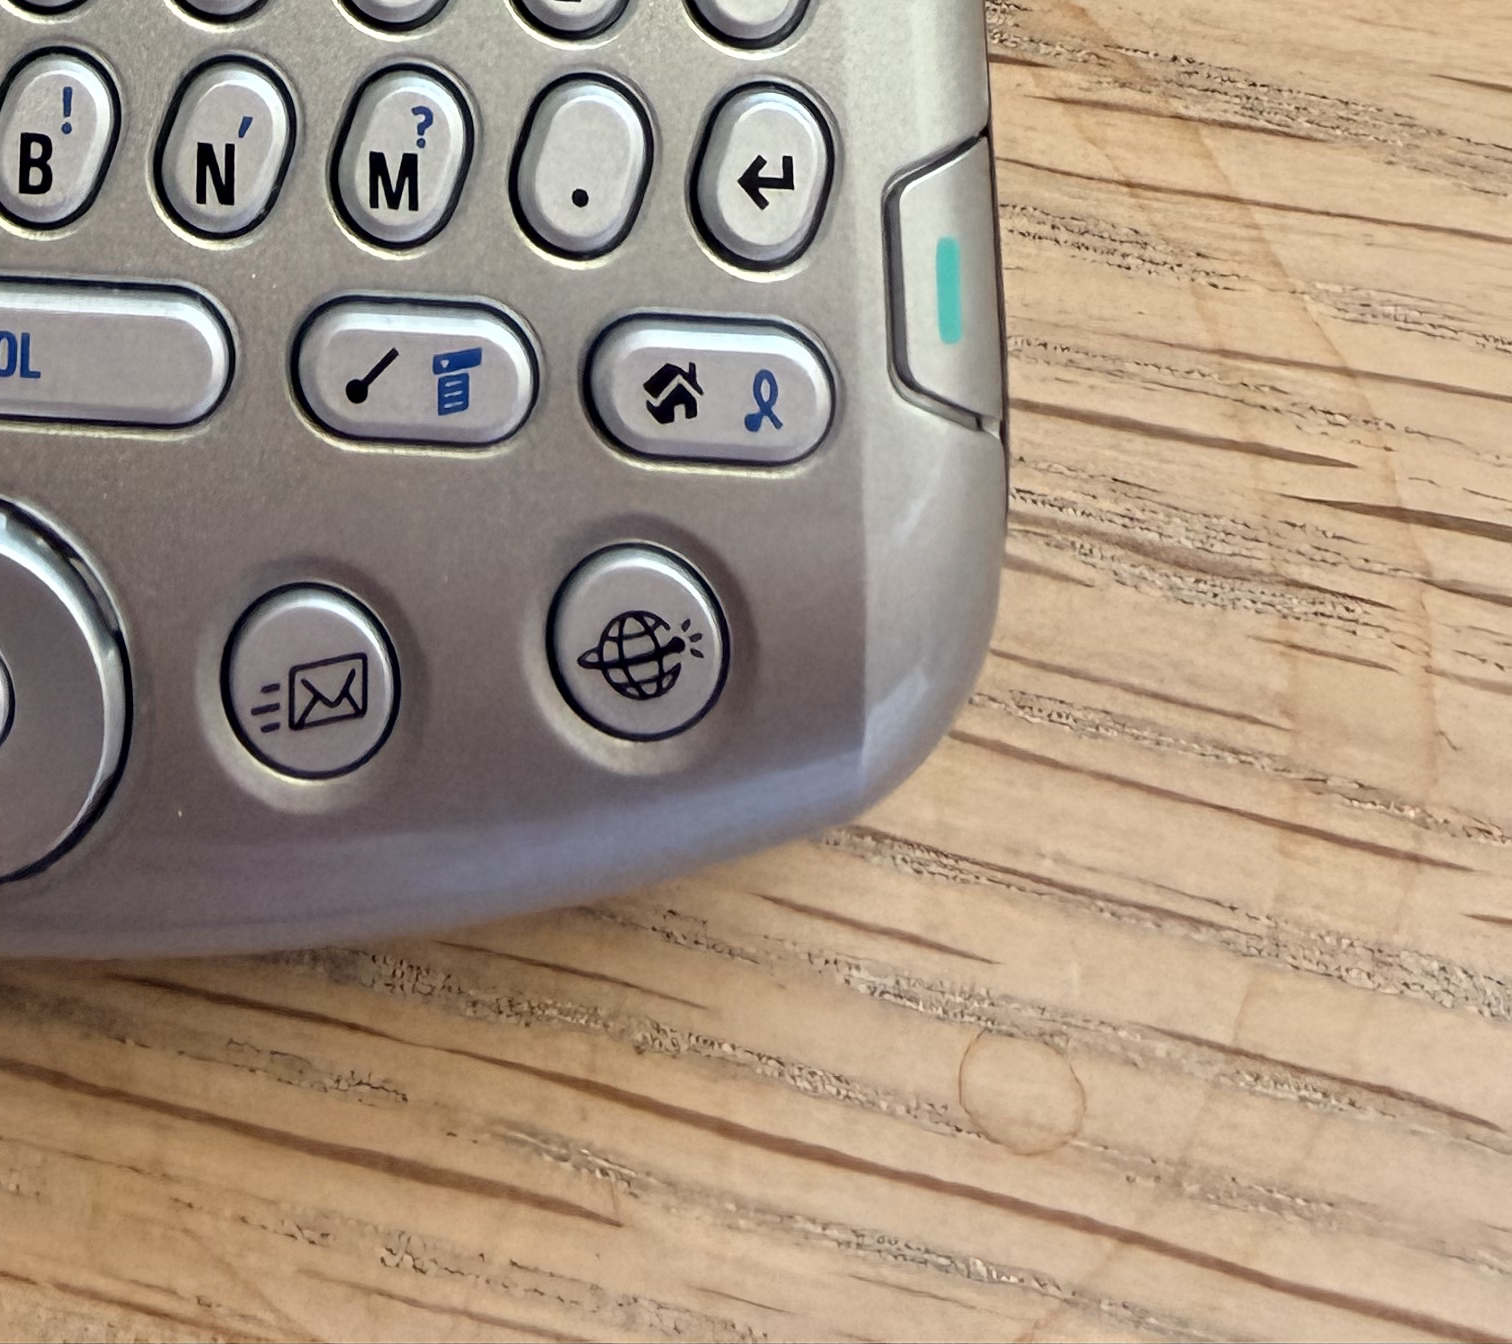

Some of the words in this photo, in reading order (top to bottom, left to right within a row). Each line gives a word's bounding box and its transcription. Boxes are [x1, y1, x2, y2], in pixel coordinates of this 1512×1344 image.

[413, 107, 432, 147] ?
[19, 133, 52, 194] B
[196, 142, 235, 205] N
[369, 151, 418, 211] M
